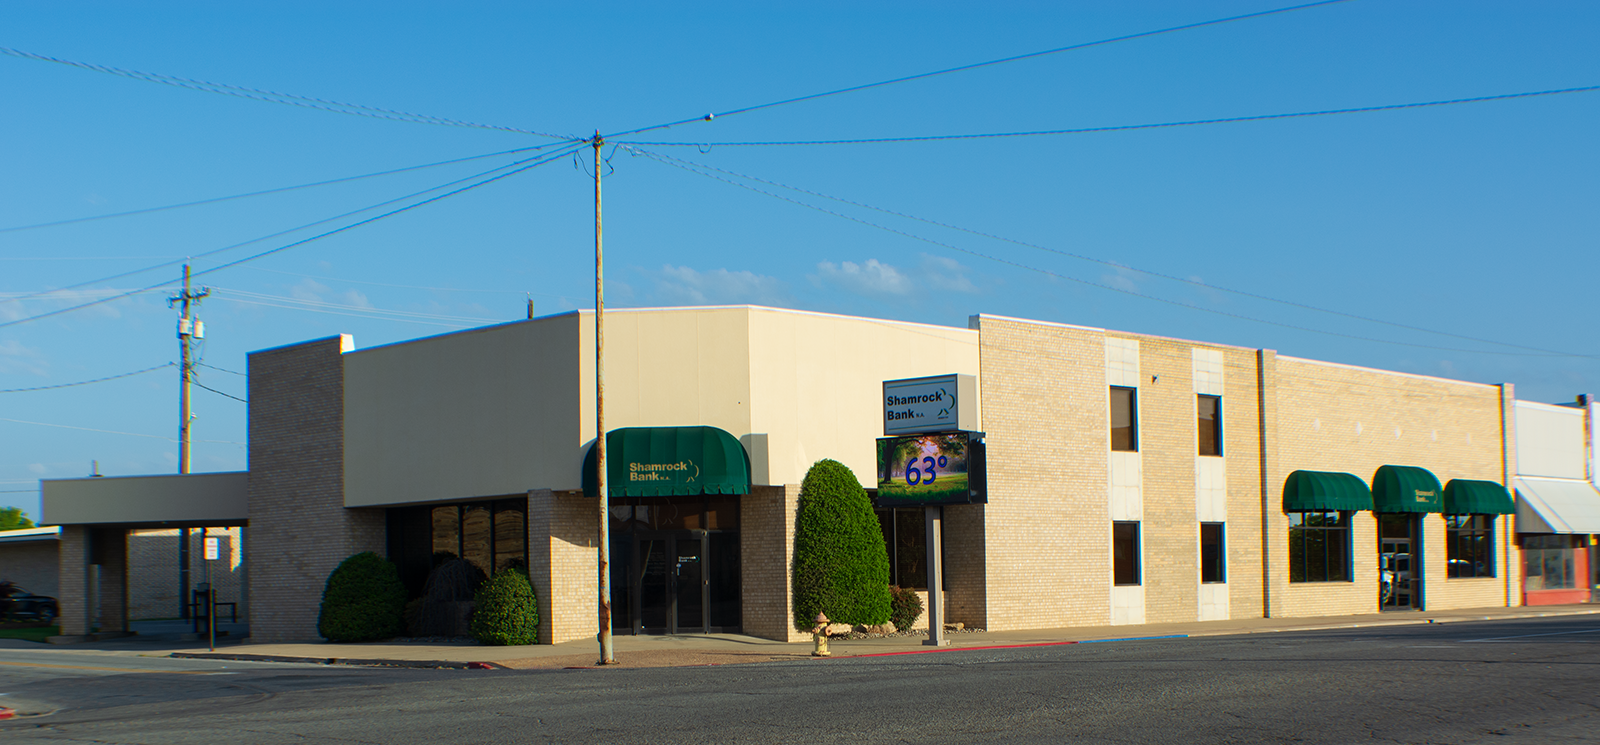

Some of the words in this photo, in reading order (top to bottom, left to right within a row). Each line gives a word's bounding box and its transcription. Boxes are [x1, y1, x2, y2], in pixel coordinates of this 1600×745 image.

[887, 391, 942, 406] Shamrock
[887, 409, 915, 420] Bank
[629, 461, 688, 472] Shamrock
[629, 472, 659, 481] Bank
